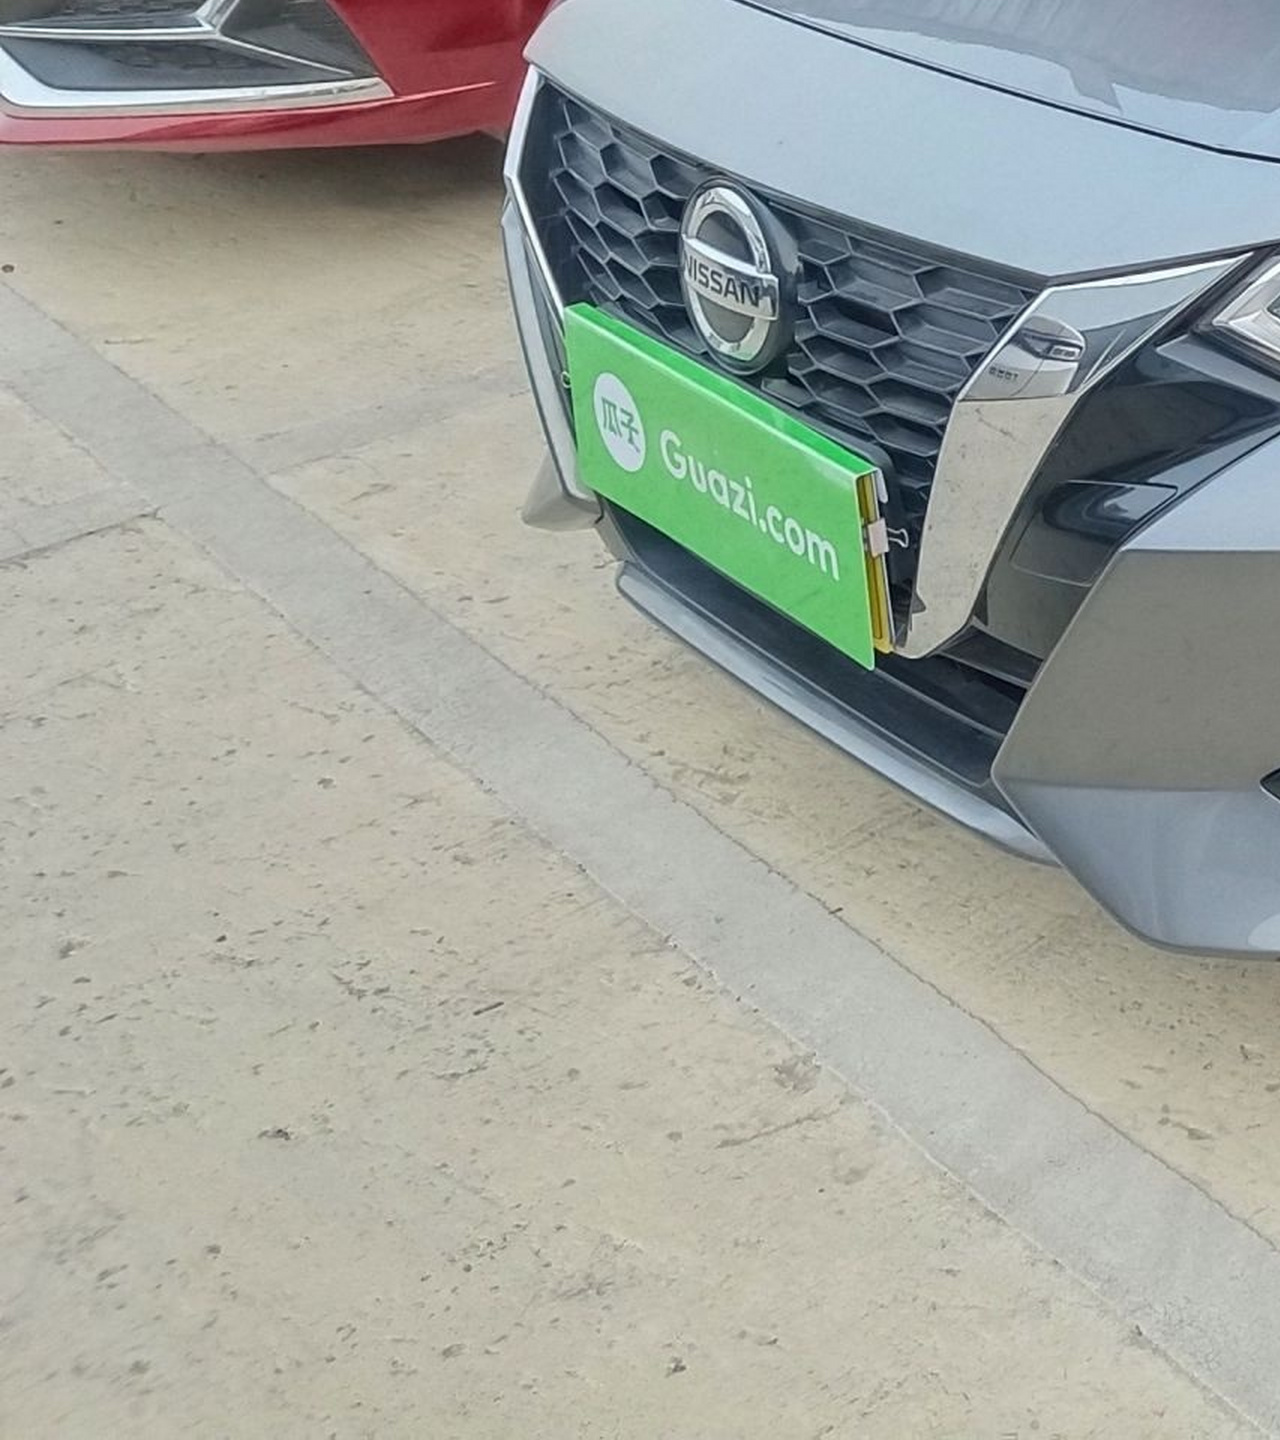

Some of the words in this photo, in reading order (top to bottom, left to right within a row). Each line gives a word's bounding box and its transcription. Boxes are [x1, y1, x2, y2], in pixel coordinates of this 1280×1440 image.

[683, 254, 759, 307] NISSAN
[601, 396, 640, 454] 瓜子
[660, 429, 840, 582] Guazi.com
